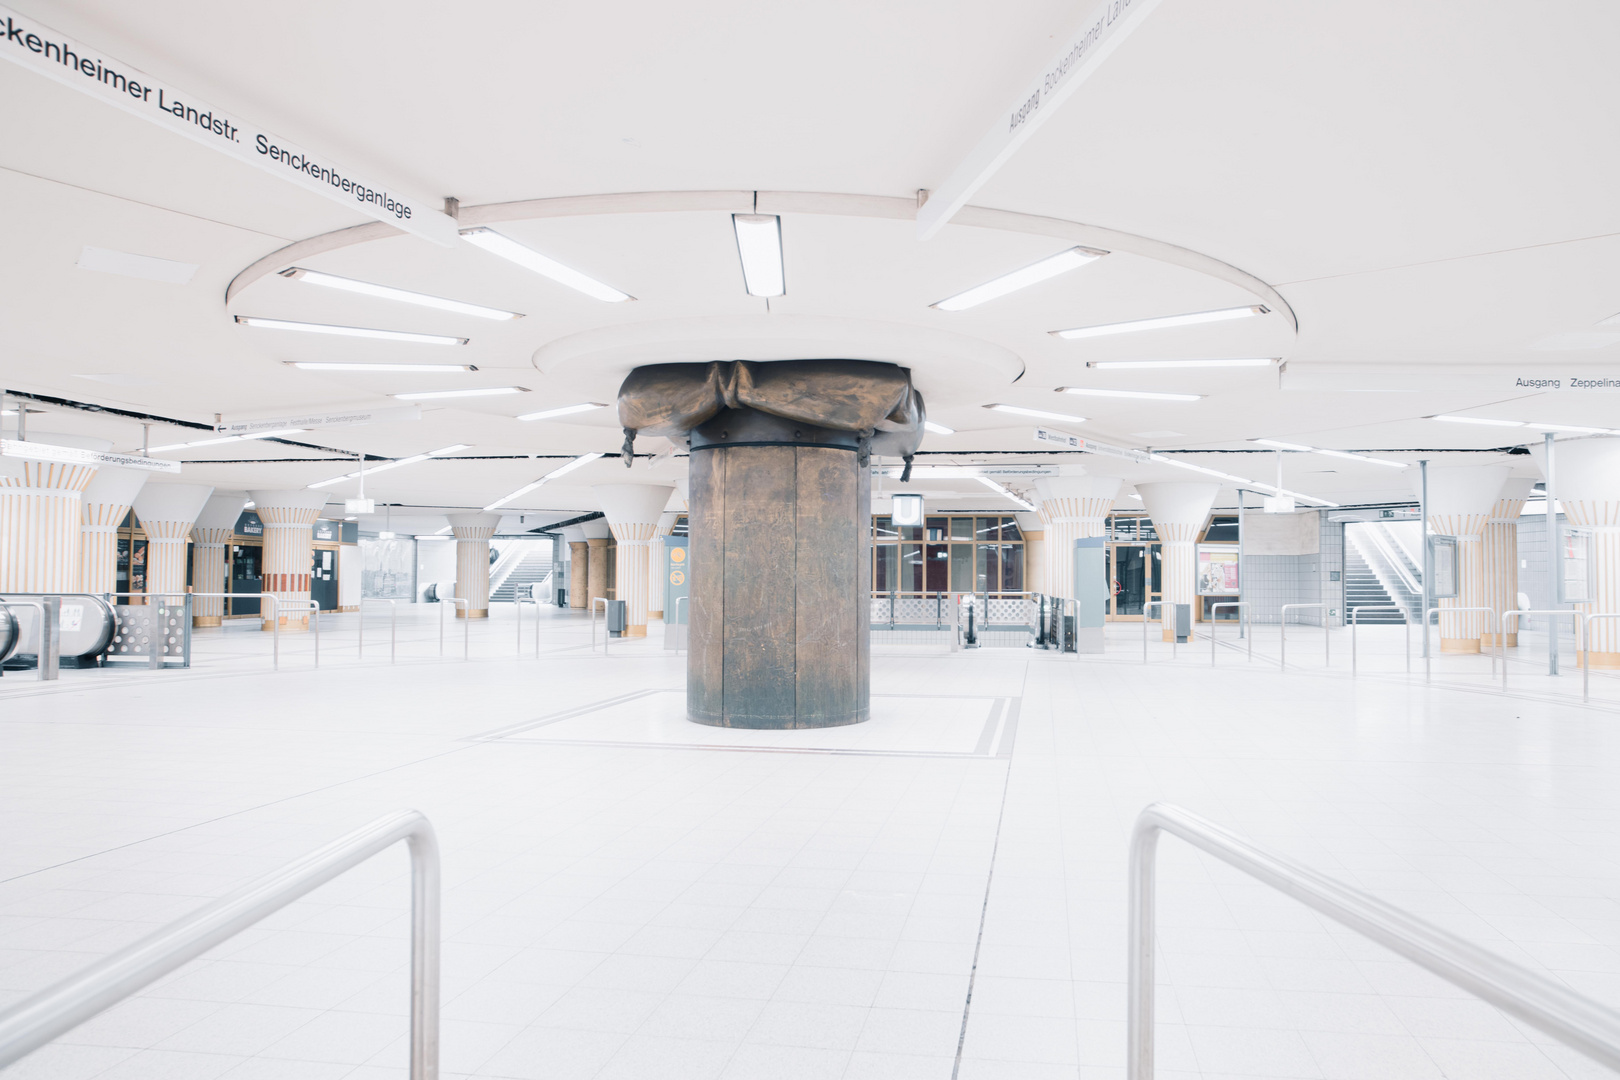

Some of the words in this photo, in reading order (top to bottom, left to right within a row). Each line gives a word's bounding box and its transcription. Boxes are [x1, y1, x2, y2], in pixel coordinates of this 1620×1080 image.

[1009, 88, 1040, 133] Ausgang
[1044, 16, 1105, 95] Bockenheimer
[1106, 0, 1133, 27] Lan
[158, 88, 241, 143] Landstr.
[256, 134, 413, 219] Senckenberganlage
[1515, 377, 1561, 389] Ausgang
[894, 496, 920, 525] U
[244, 526, 262, 534] BAKERY
